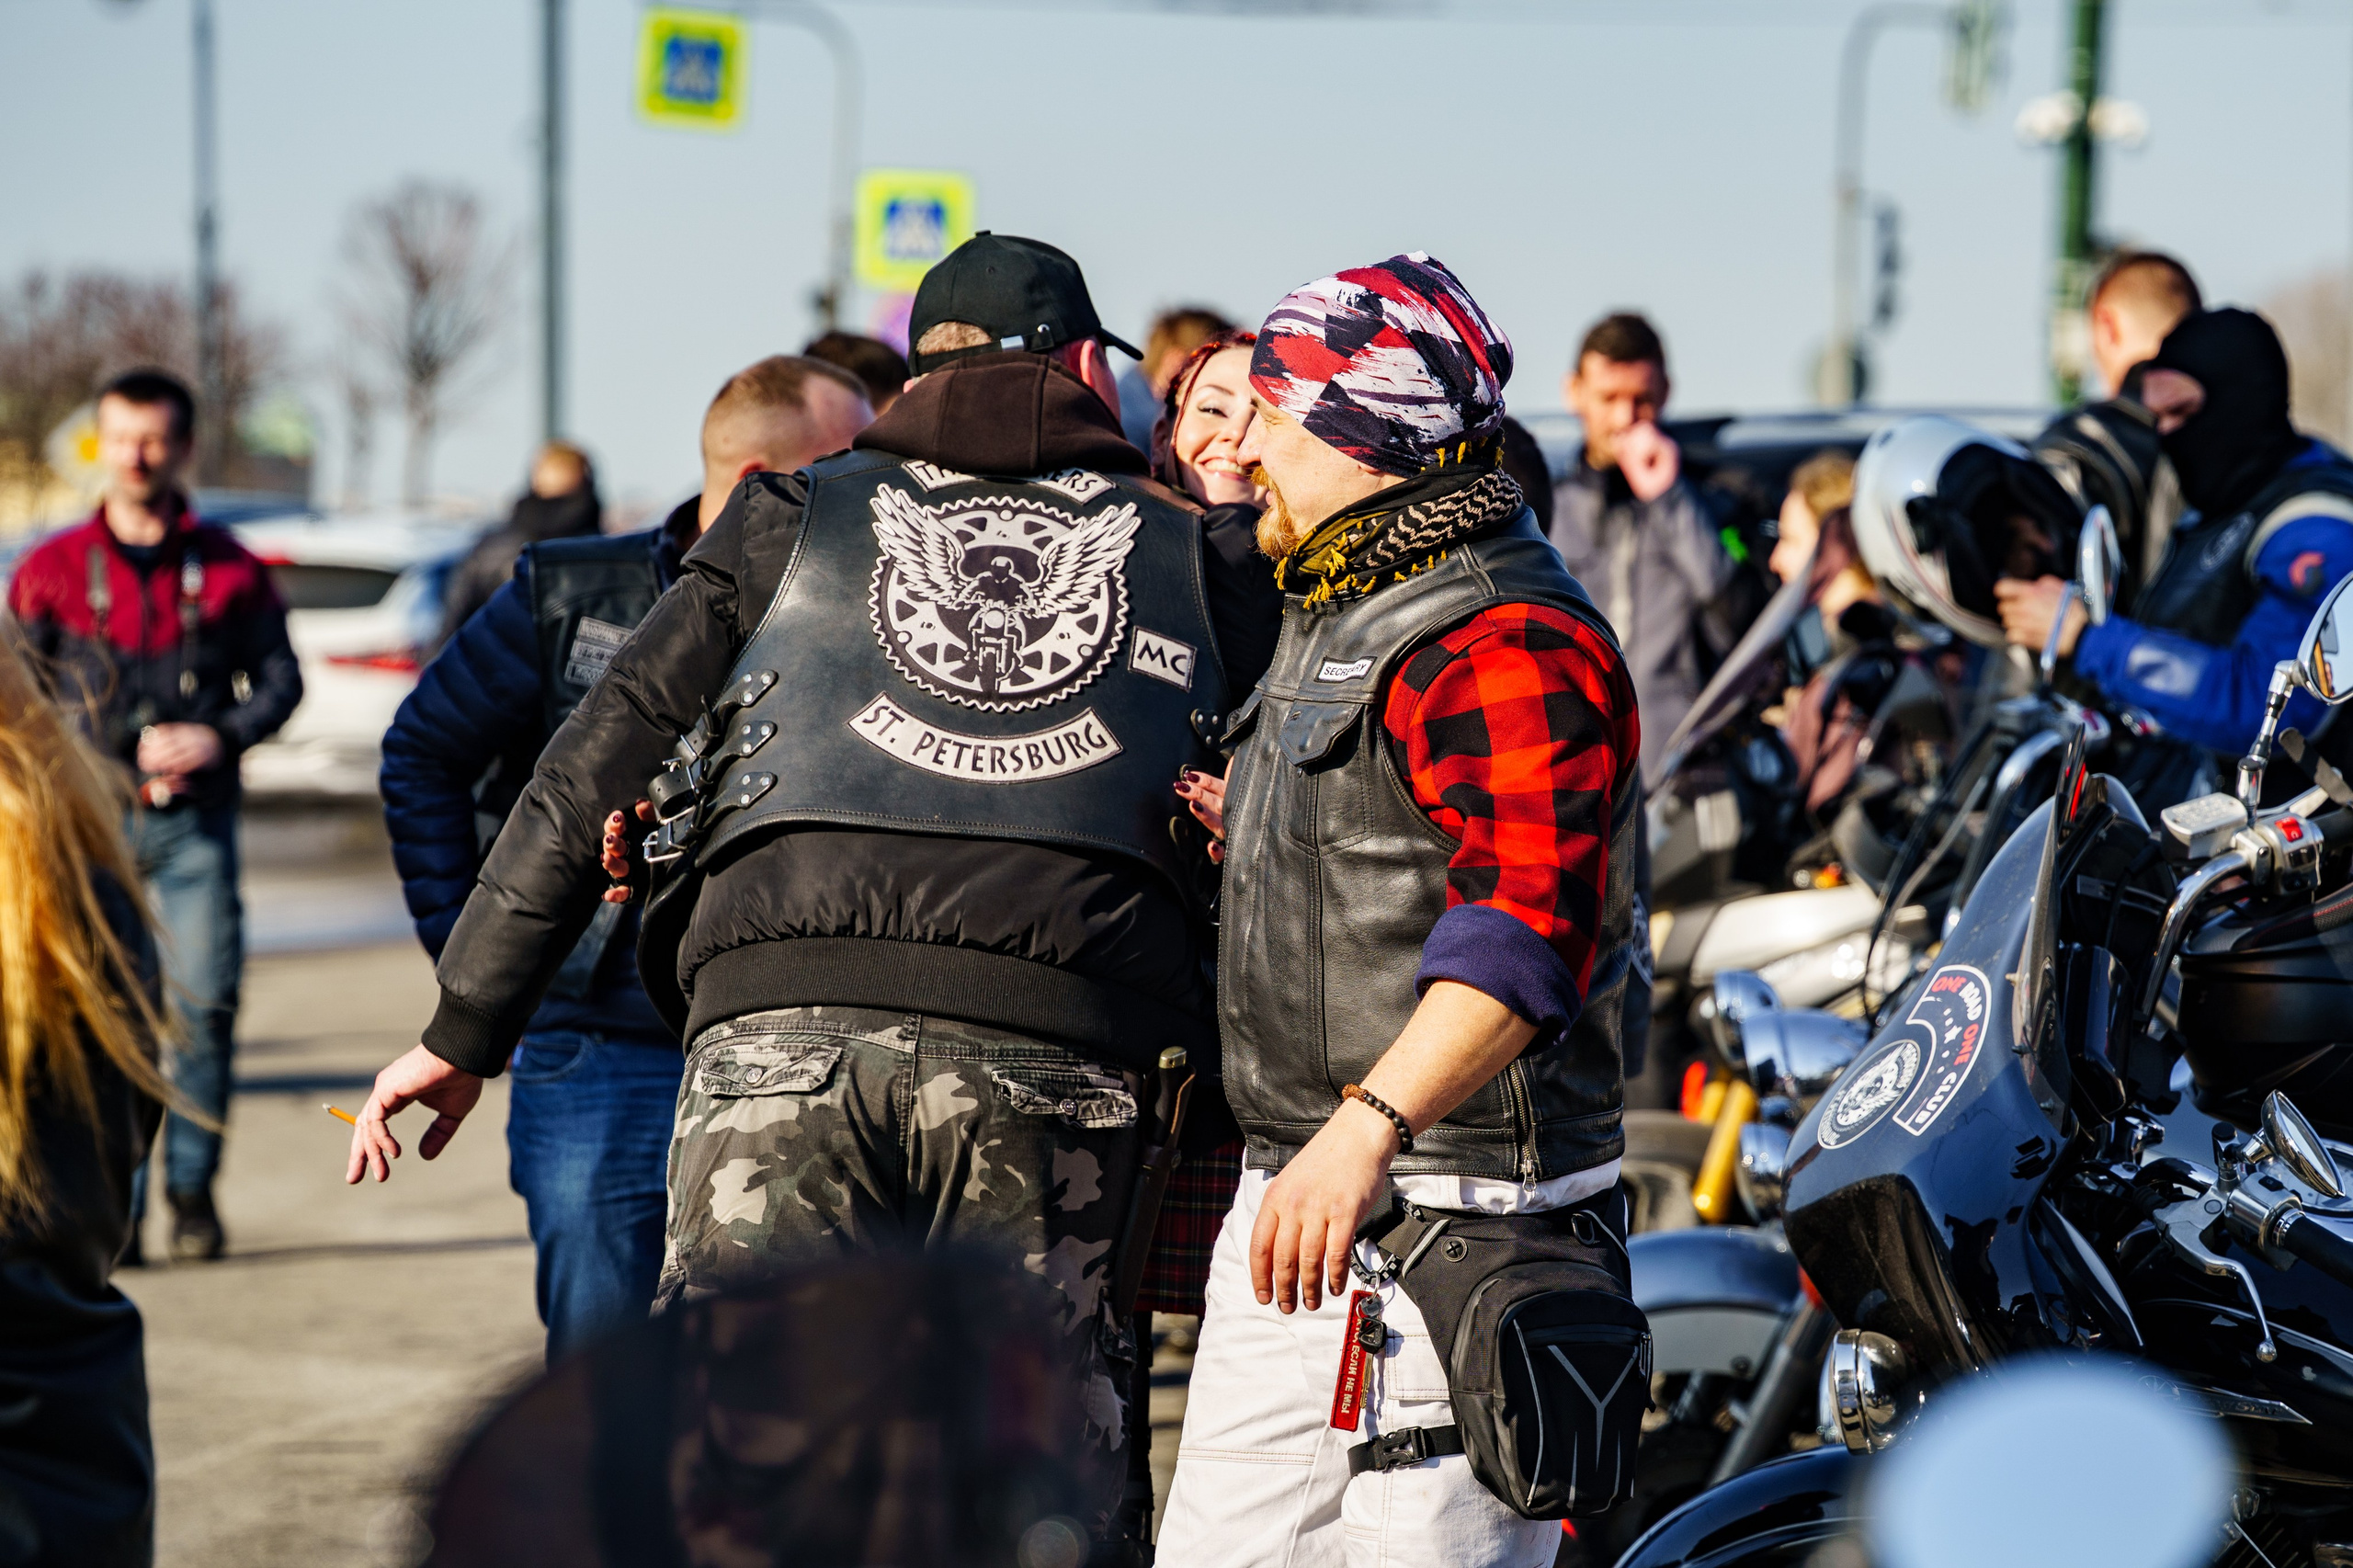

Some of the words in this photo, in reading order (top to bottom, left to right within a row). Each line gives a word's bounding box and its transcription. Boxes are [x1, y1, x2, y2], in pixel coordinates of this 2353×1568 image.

[1137, 639, 1187, 677] MC
[862, 705, 905, 744] ST.
[912, 722, 1108, 774] PETERSBURG
[1931, 976, 1967, 994] ONE
[1953, 1023, 1979, 1066] ONE
[1915, 1072, 1957, 1124] CLUB
[1347, 1345, 1360, 1375] ЕСЛИ
[1345, 1377, 1356, 1392] НЕ
[1341, 1393, 1353, 1414] МЫ
